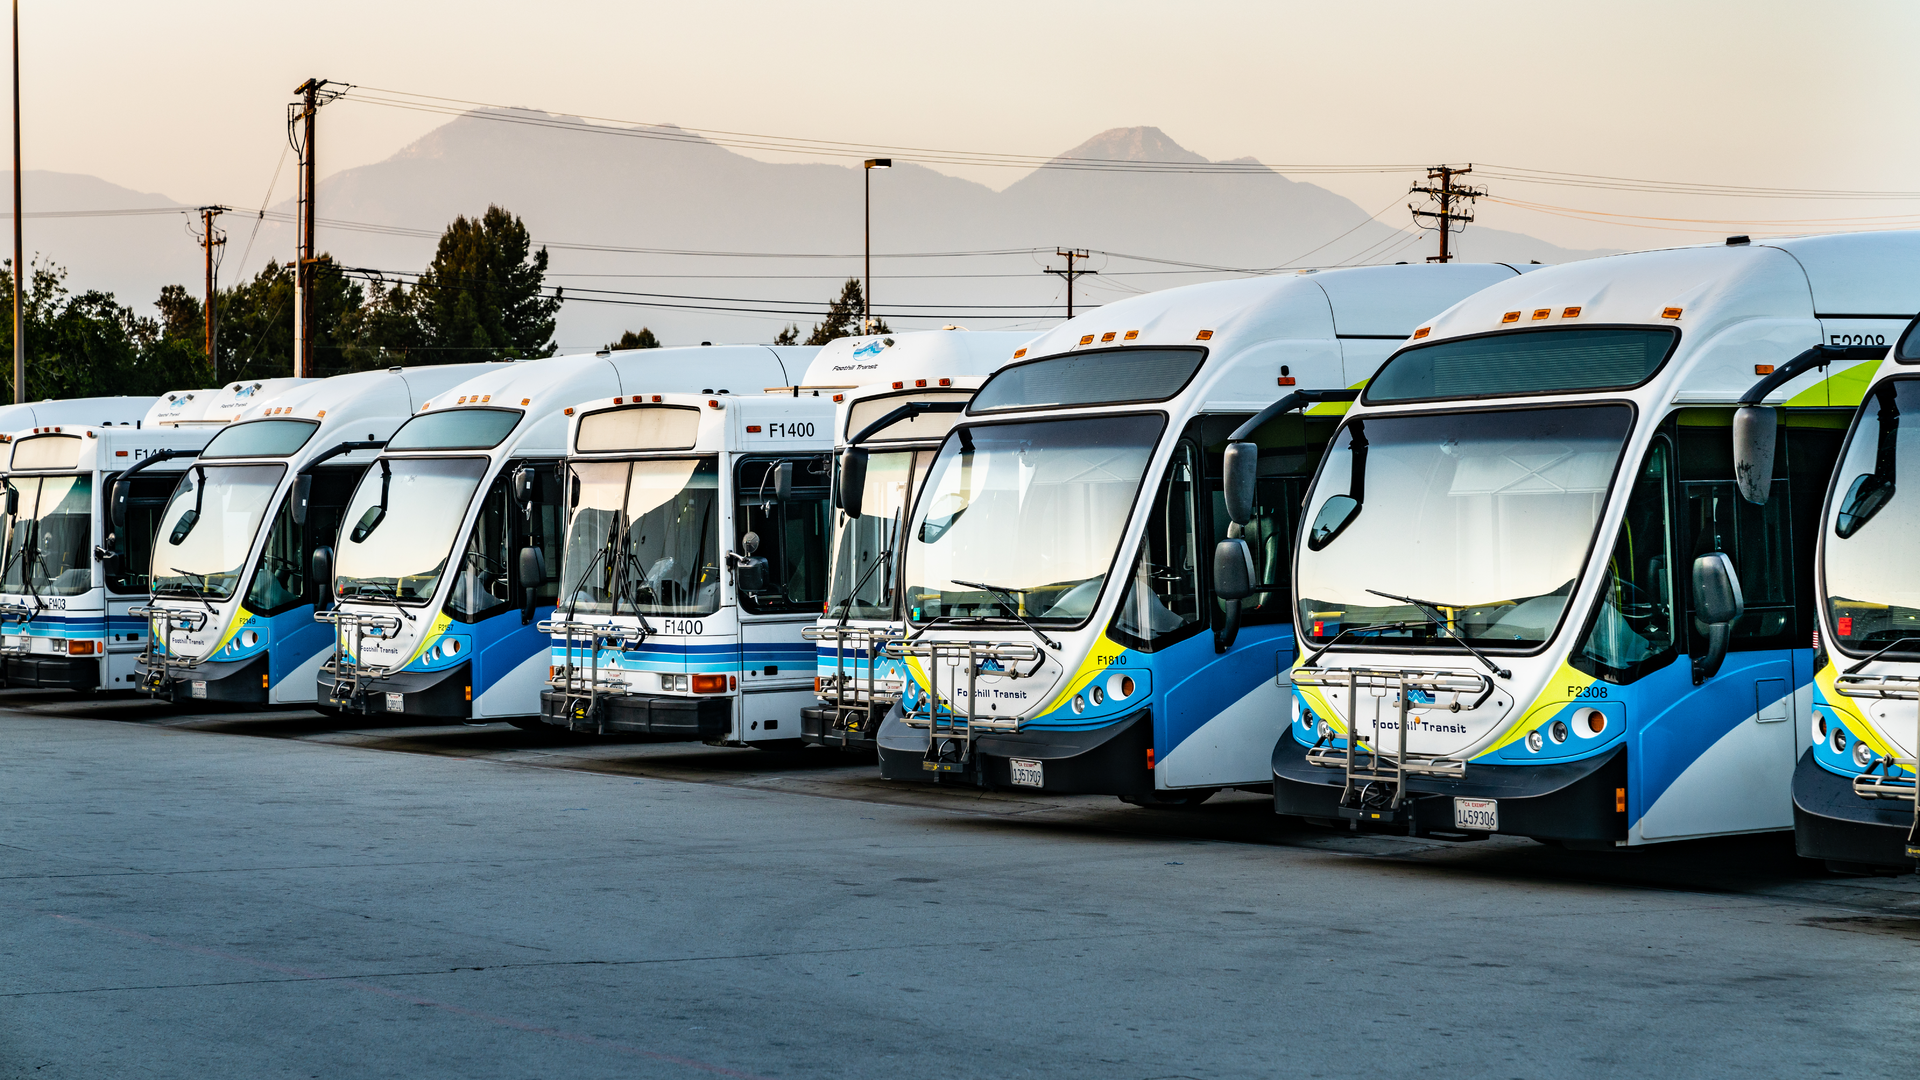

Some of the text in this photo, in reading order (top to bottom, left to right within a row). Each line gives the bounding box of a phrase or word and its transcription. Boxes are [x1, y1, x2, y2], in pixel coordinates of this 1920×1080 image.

[769, 422, 815, 438] F1400
[48, 598, 66, 610] F1403
[664, 619, 703, 635] F1400
[1097, 655, 1127, 665] F1810
[957, 688, 1027, 699] Fothill Transit
[1567, 686, 1608, 699] F2308
[1372, 719, 1467, 734] Footill Transit
[1013, 768, 1042, 783] 1357909
[1458, 809, 1496, 826] 1459306
